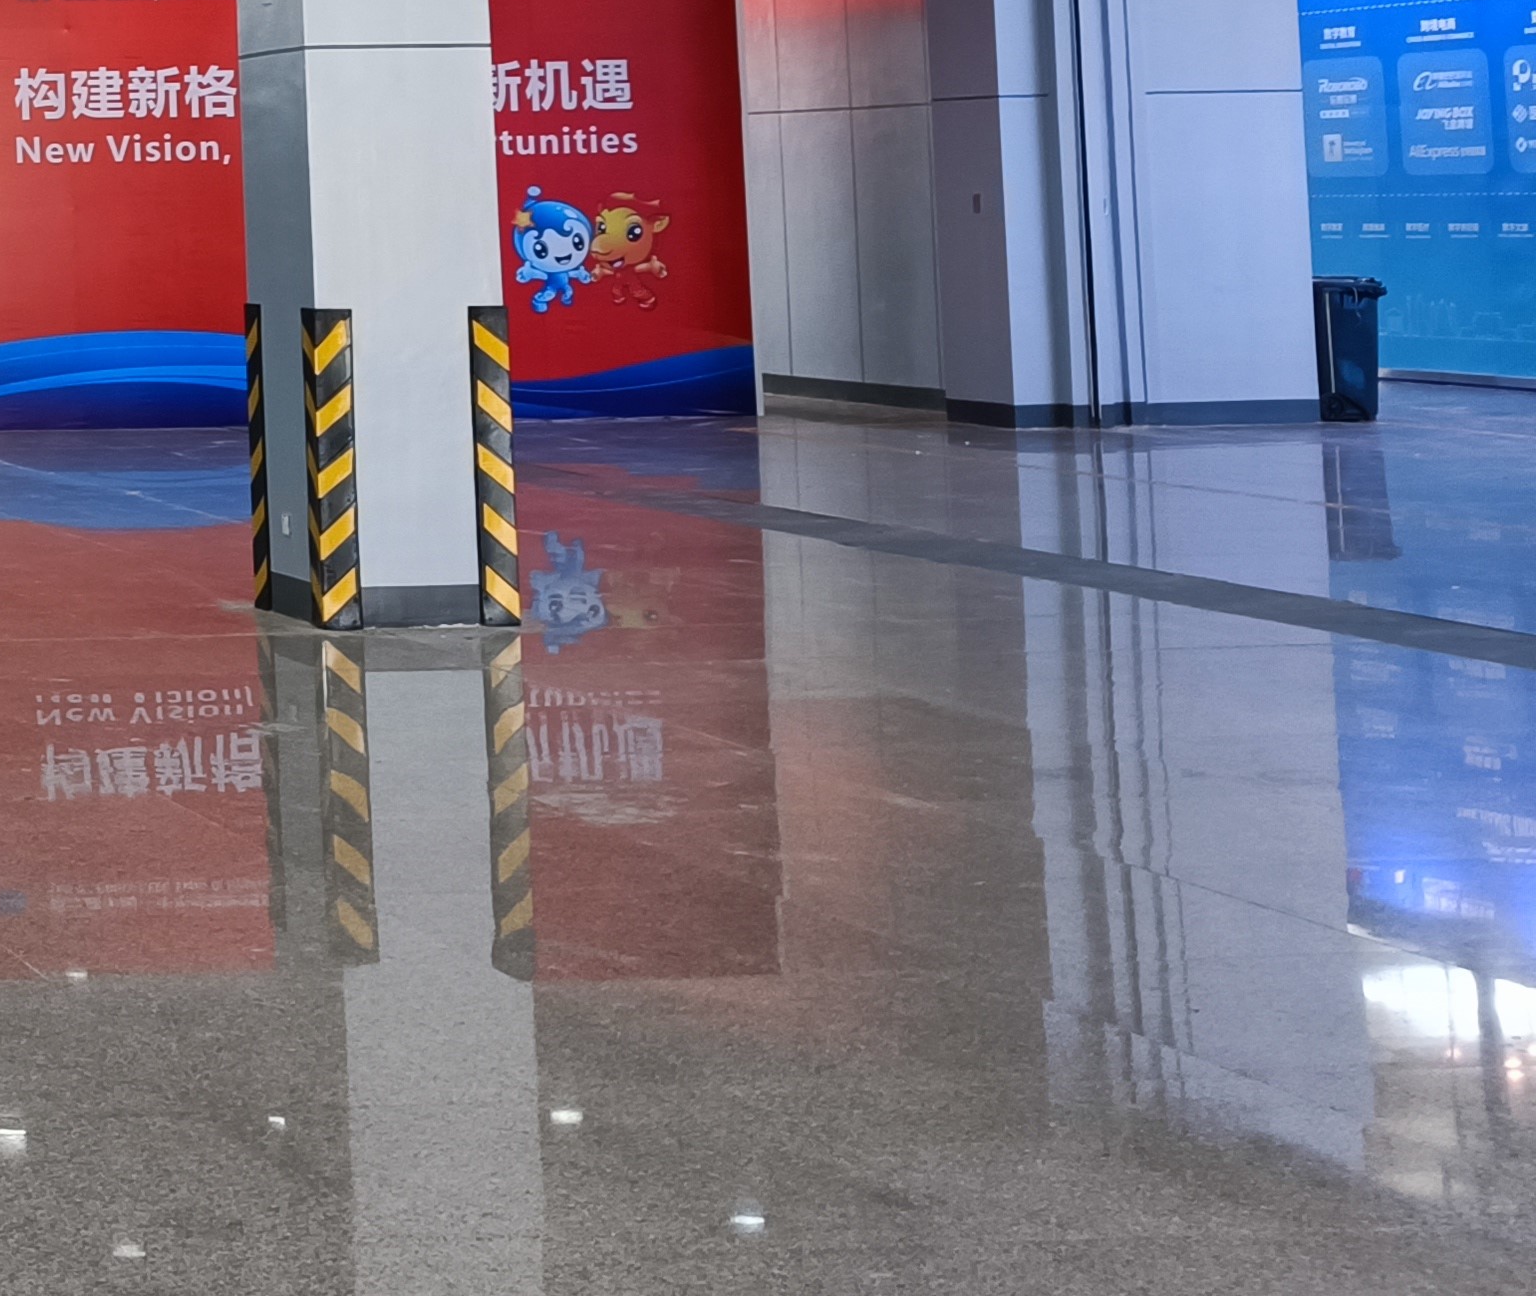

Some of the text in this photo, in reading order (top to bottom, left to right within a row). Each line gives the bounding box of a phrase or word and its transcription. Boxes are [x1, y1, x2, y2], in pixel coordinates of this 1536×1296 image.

[14, 65, 237, 121] 构建新格
[15, 125, 638, 165] New Vision, tunities
